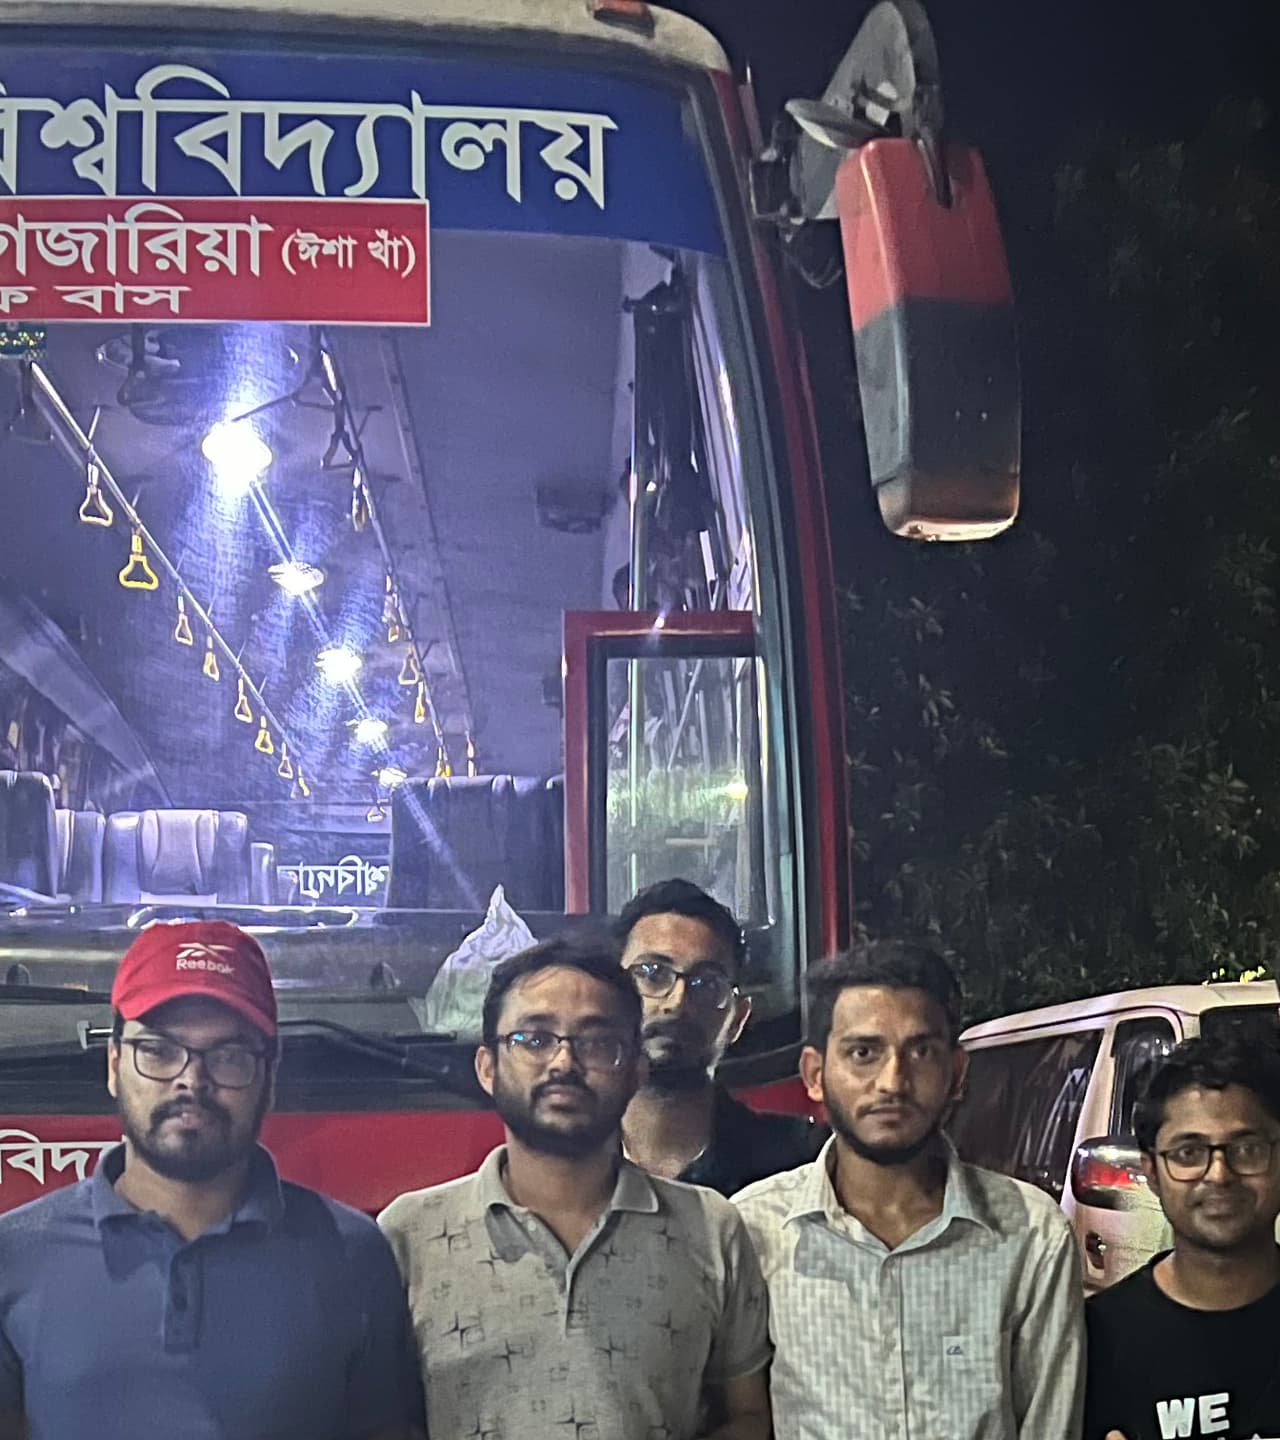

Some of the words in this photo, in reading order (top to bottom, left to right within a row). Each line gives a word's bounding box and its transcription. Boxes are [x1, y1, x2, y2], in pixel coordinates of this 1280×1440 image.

[54, 282, 192, 314] বাস
[176, 958, 235, 975] Reebok
[1156, 1392, 1230, 1440] WE
